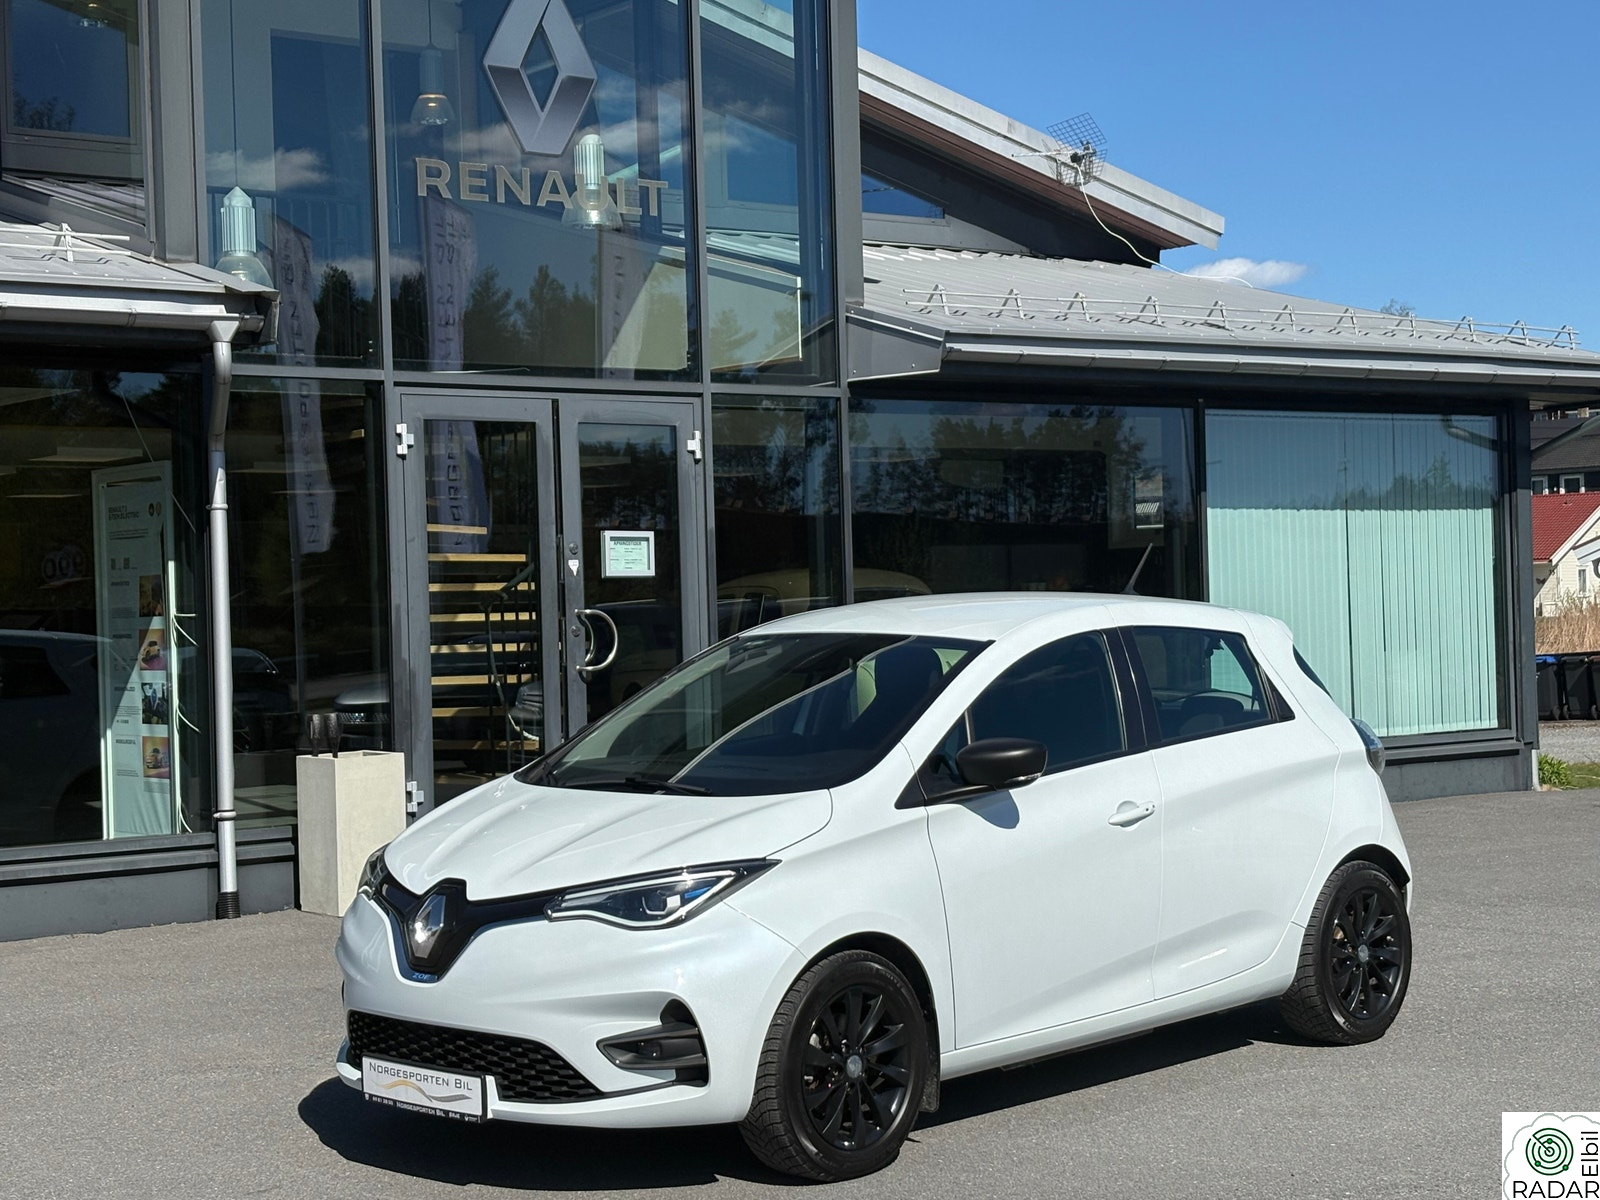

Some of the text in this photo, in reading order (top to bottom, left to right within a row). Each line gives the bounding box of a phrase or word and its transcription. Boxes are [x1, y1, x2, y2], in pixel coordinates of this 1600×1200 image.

[415, 157, 669, 217] RENAULT
[369, 1062, 473, 1091] NORGESPORTEN BIL
[396, 1101, 436, 1115] NORGESPORTEN
